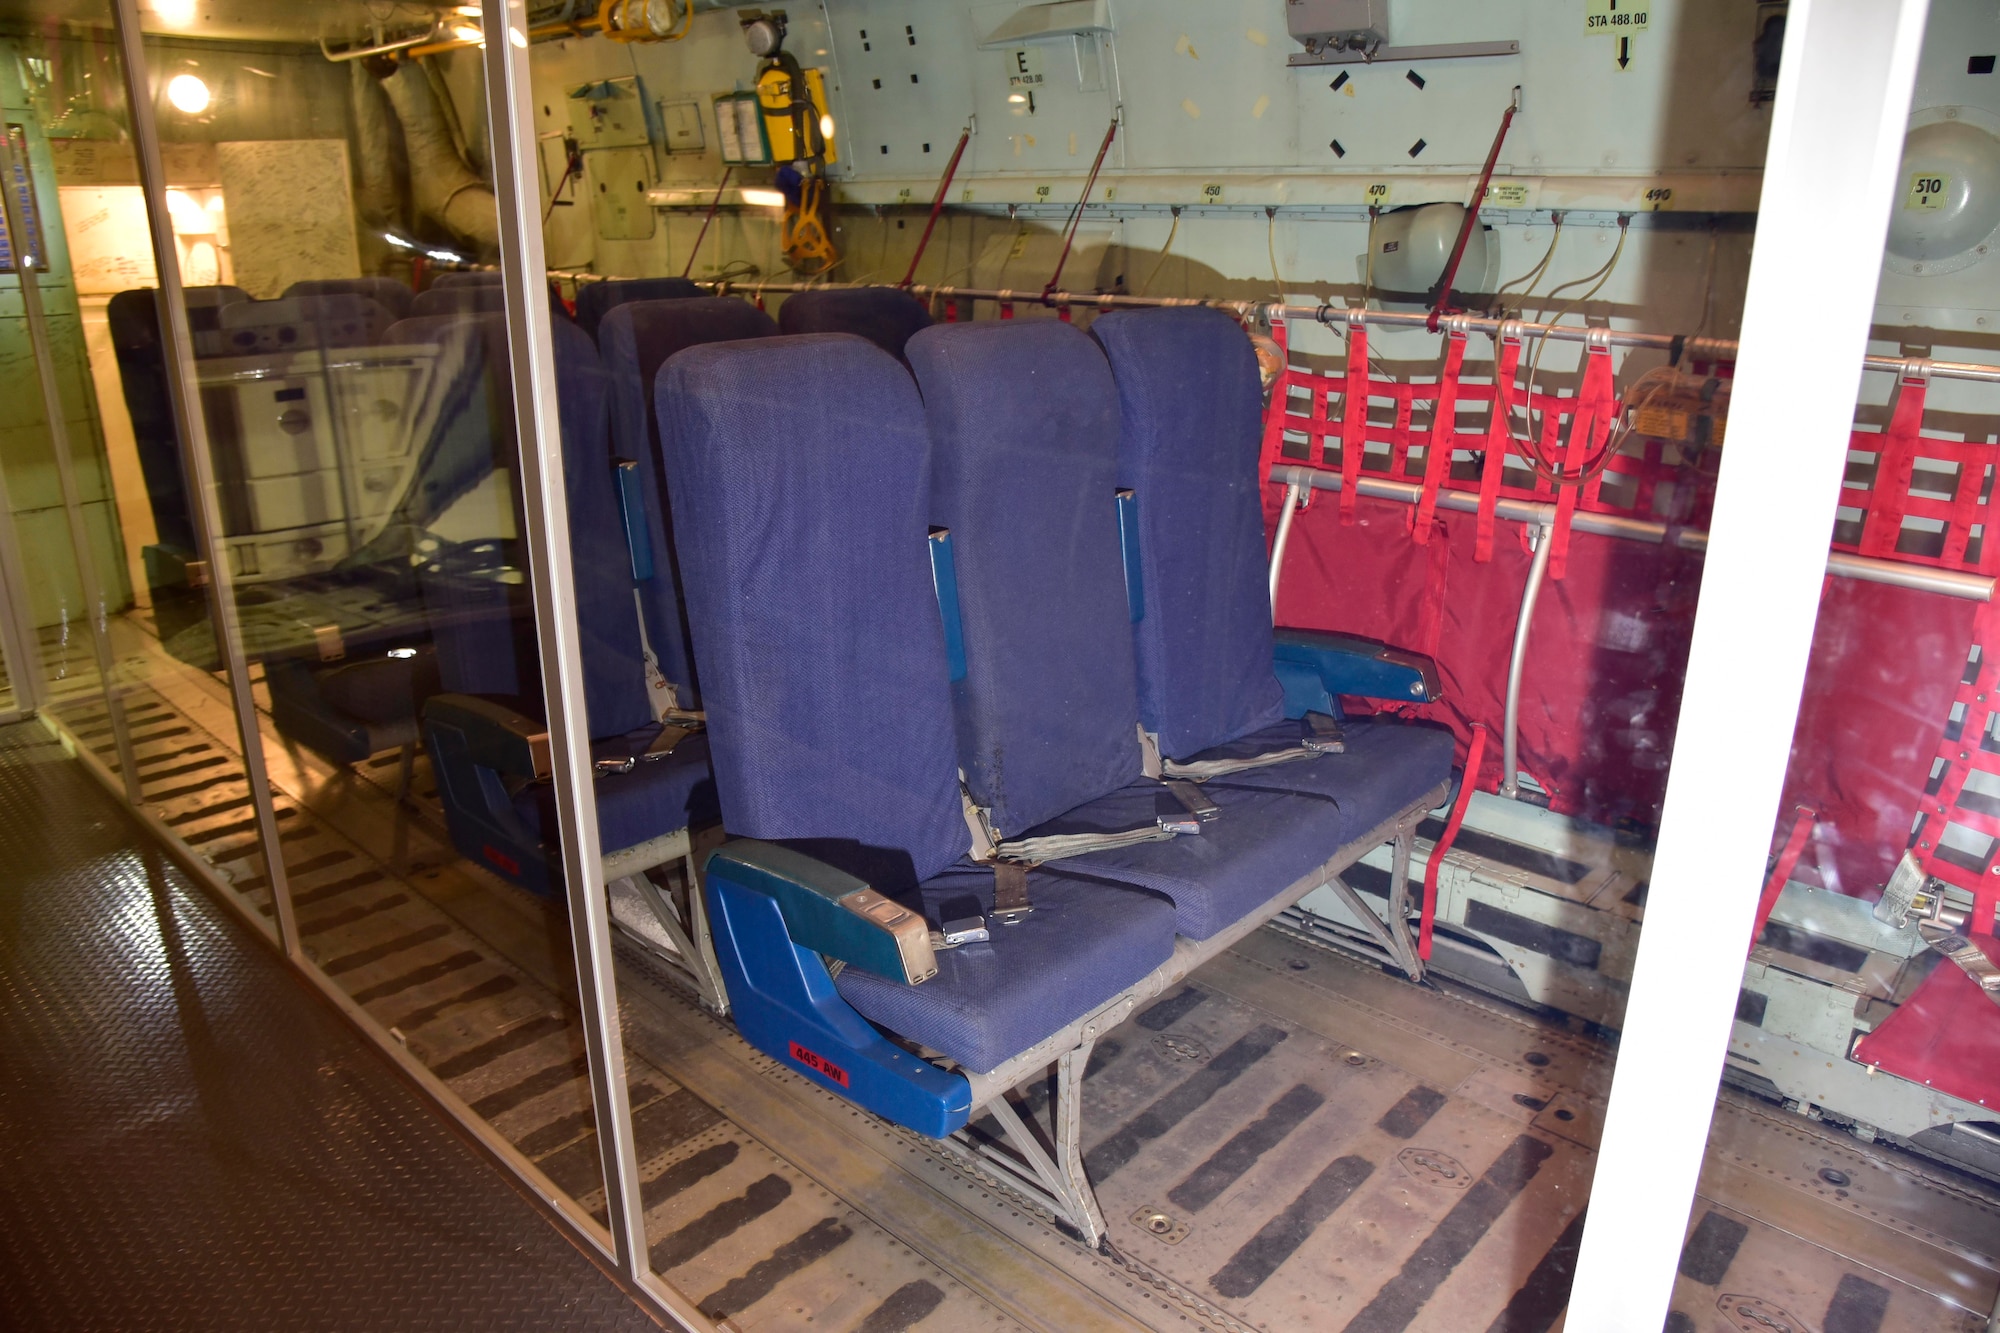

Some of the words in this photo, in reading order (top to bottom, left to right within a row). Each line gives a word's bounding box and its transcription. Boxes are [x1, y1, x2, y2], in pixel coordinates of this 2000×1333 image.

[1588, 15, 1607, 27] STA
[1610, 12, 1647, 26] 488.00
[1016, 52, 1028, 73] E
[1036, 186, 1050, 196] 430
[1204, 185, 1221, 196] 450
[1368, 185, 1386, 196] 470
[1915, 179, 1941, 193] 510
[1645, 188, 1672, 201] 490
[796, 1047, 818, 1067] 445
[823, 1062, 841, 1081] AW
